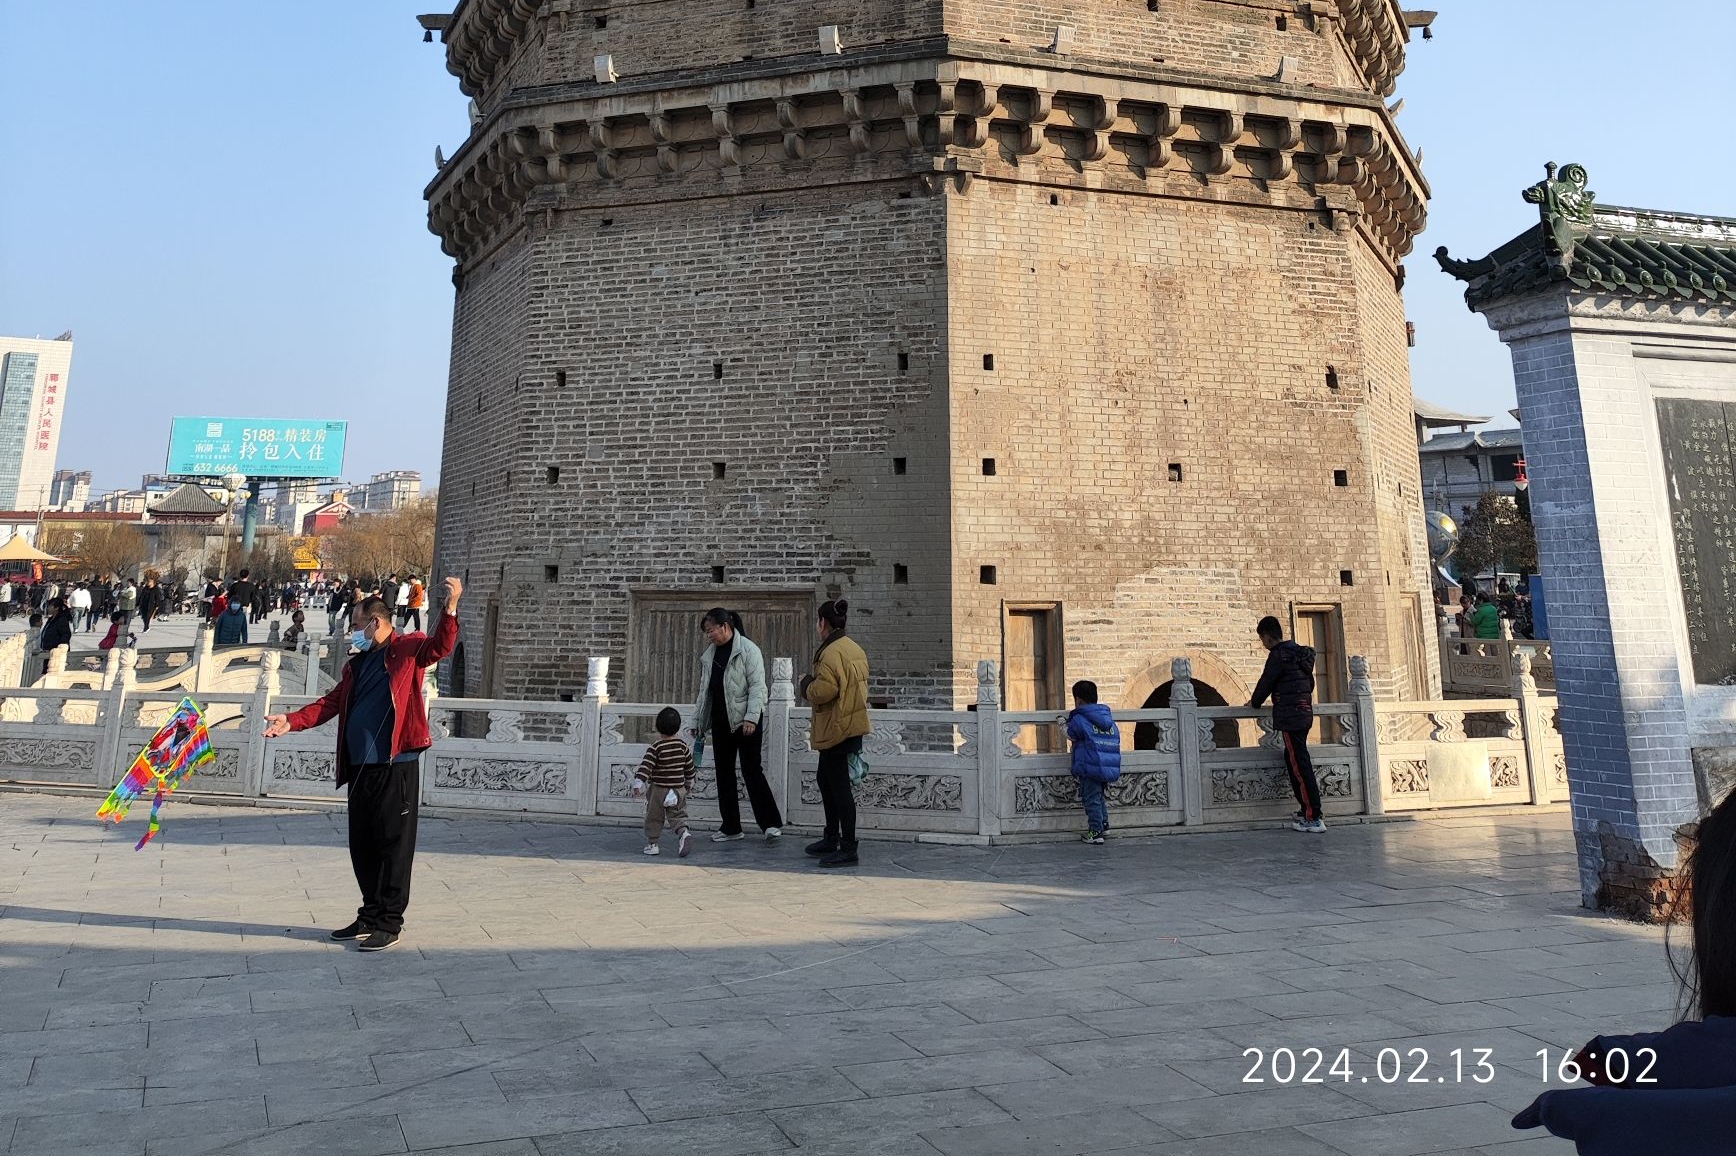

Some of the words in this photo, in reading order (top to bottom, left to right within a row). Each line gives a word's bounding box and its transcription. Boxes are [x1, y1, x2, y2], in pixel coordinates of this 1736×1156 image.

[242, 428, 275, 442] 5188
[284, 427, 327, 443] 精装房
[239, 442, 325, 461] 拎包入住
[193, 462, 212, 472] 632
[214, 463, 238, 473] 6666
